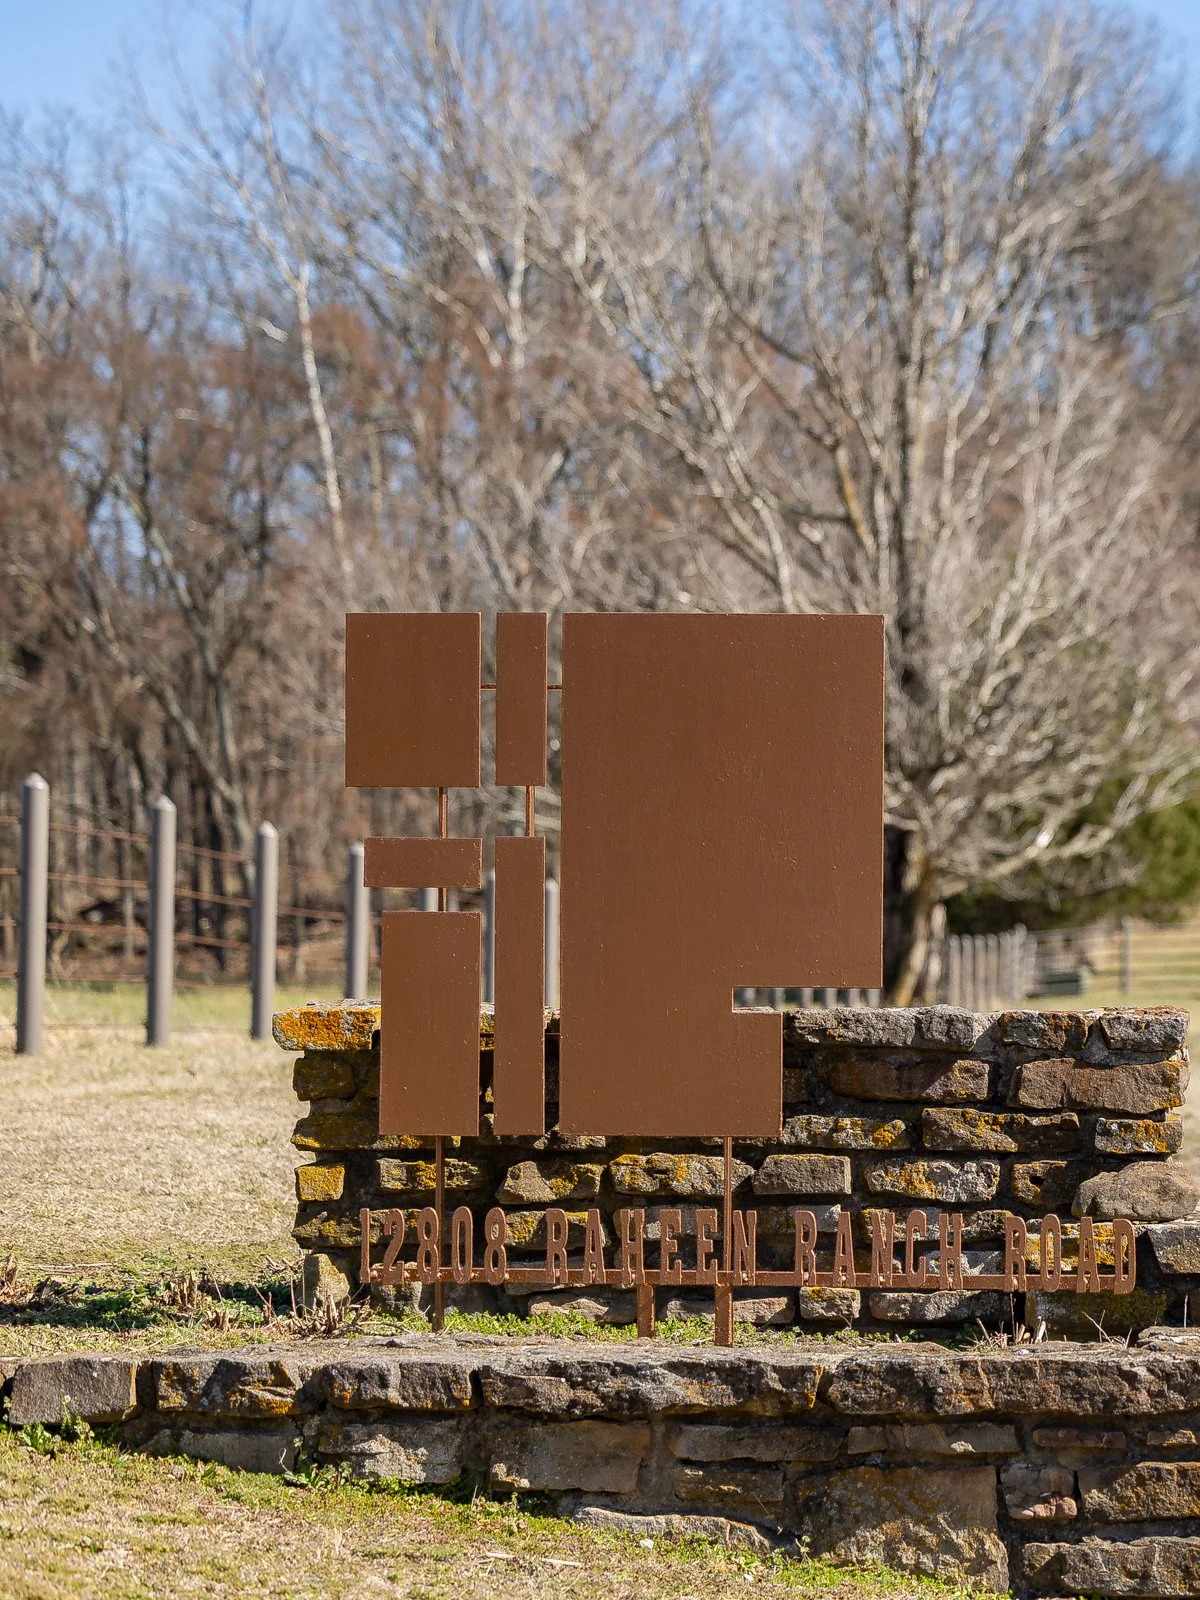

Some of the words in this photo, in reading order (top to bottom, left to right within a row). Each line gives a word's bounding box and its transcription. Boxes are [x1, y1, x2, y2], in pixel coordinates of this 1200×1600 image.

[359, 1206, 507, 1285] 12808
[545, 1208, 758, 1287] RAHEEN
[795, 1209, 964, 1290] RANCH
[1004, 1213, 1137, 1295] ROAD
